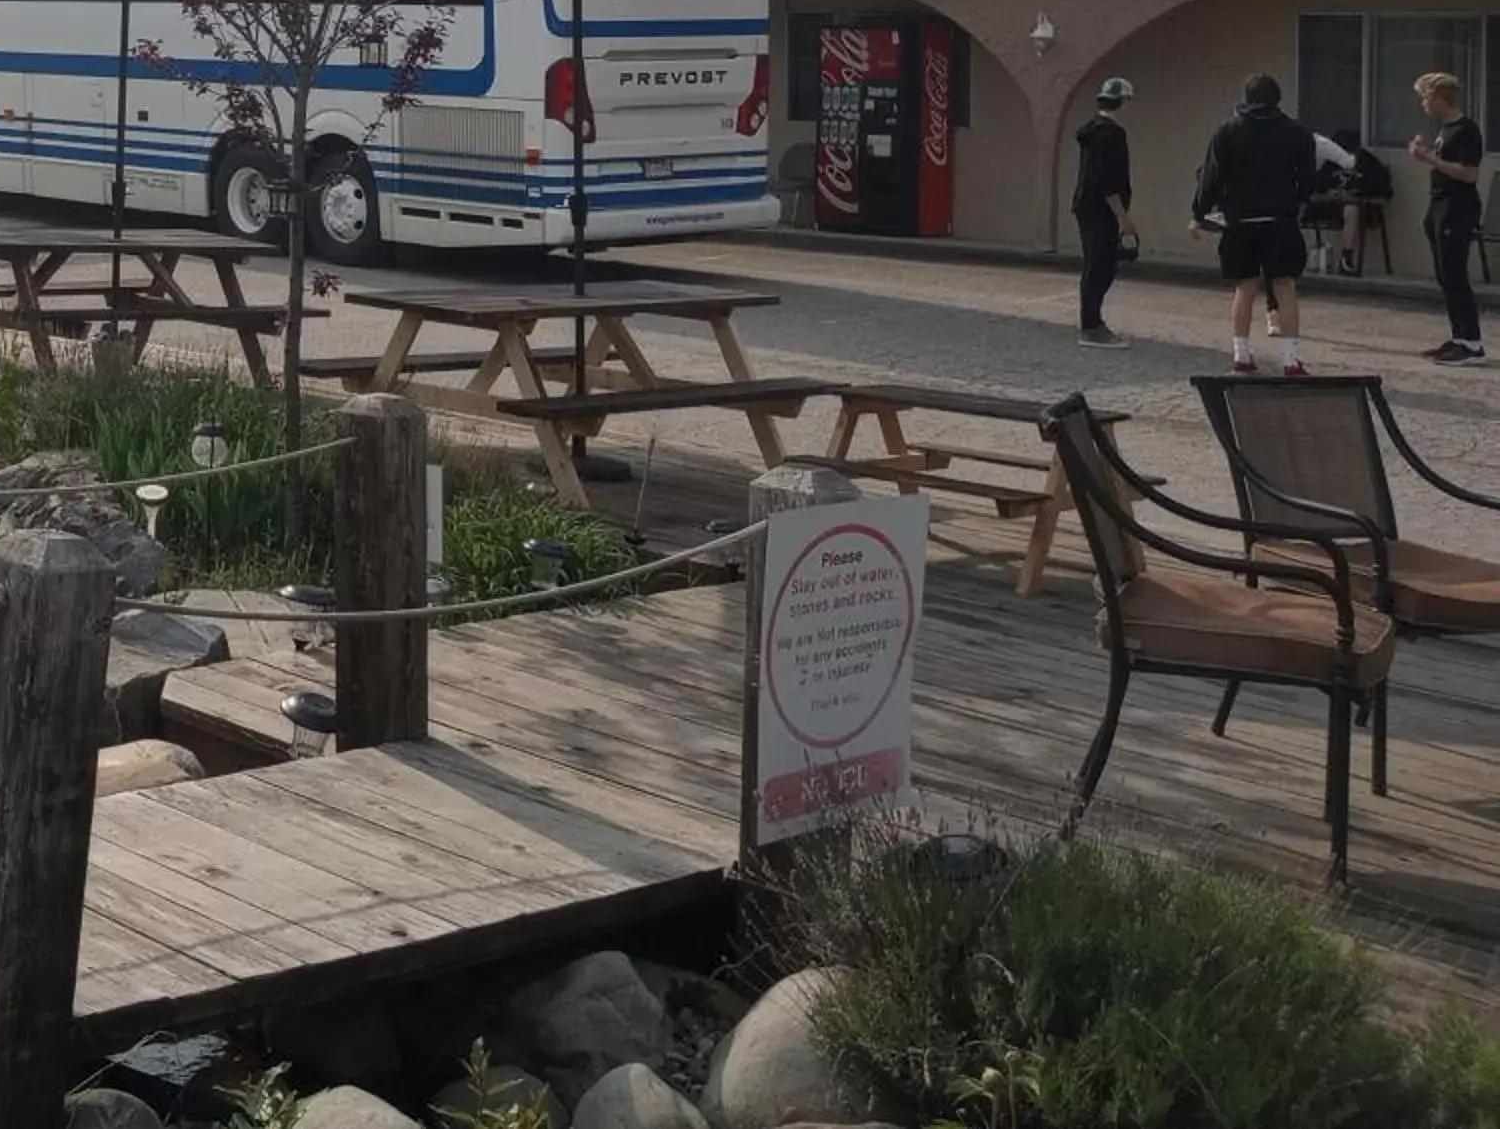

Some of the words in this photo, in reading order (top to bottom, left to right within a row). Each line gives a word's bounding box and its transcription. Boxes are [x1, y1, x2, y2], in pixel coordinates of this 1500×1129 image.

[619, 70, 729, 86] PREVOST
[820, 550, 864, 568] Please
[790, 576, 818, 595] Stay
[821, 574, 840, 589] out
[843, 571, 857, 585] of
[788, 600, 831, 619] stones
[833, 593, 856, 609] and
[795, 633, 813, 648] are
[837, 618, 902, 640] responsible
[812, 649, 833, 665] any
[835, 638, 889, 659] accidents
